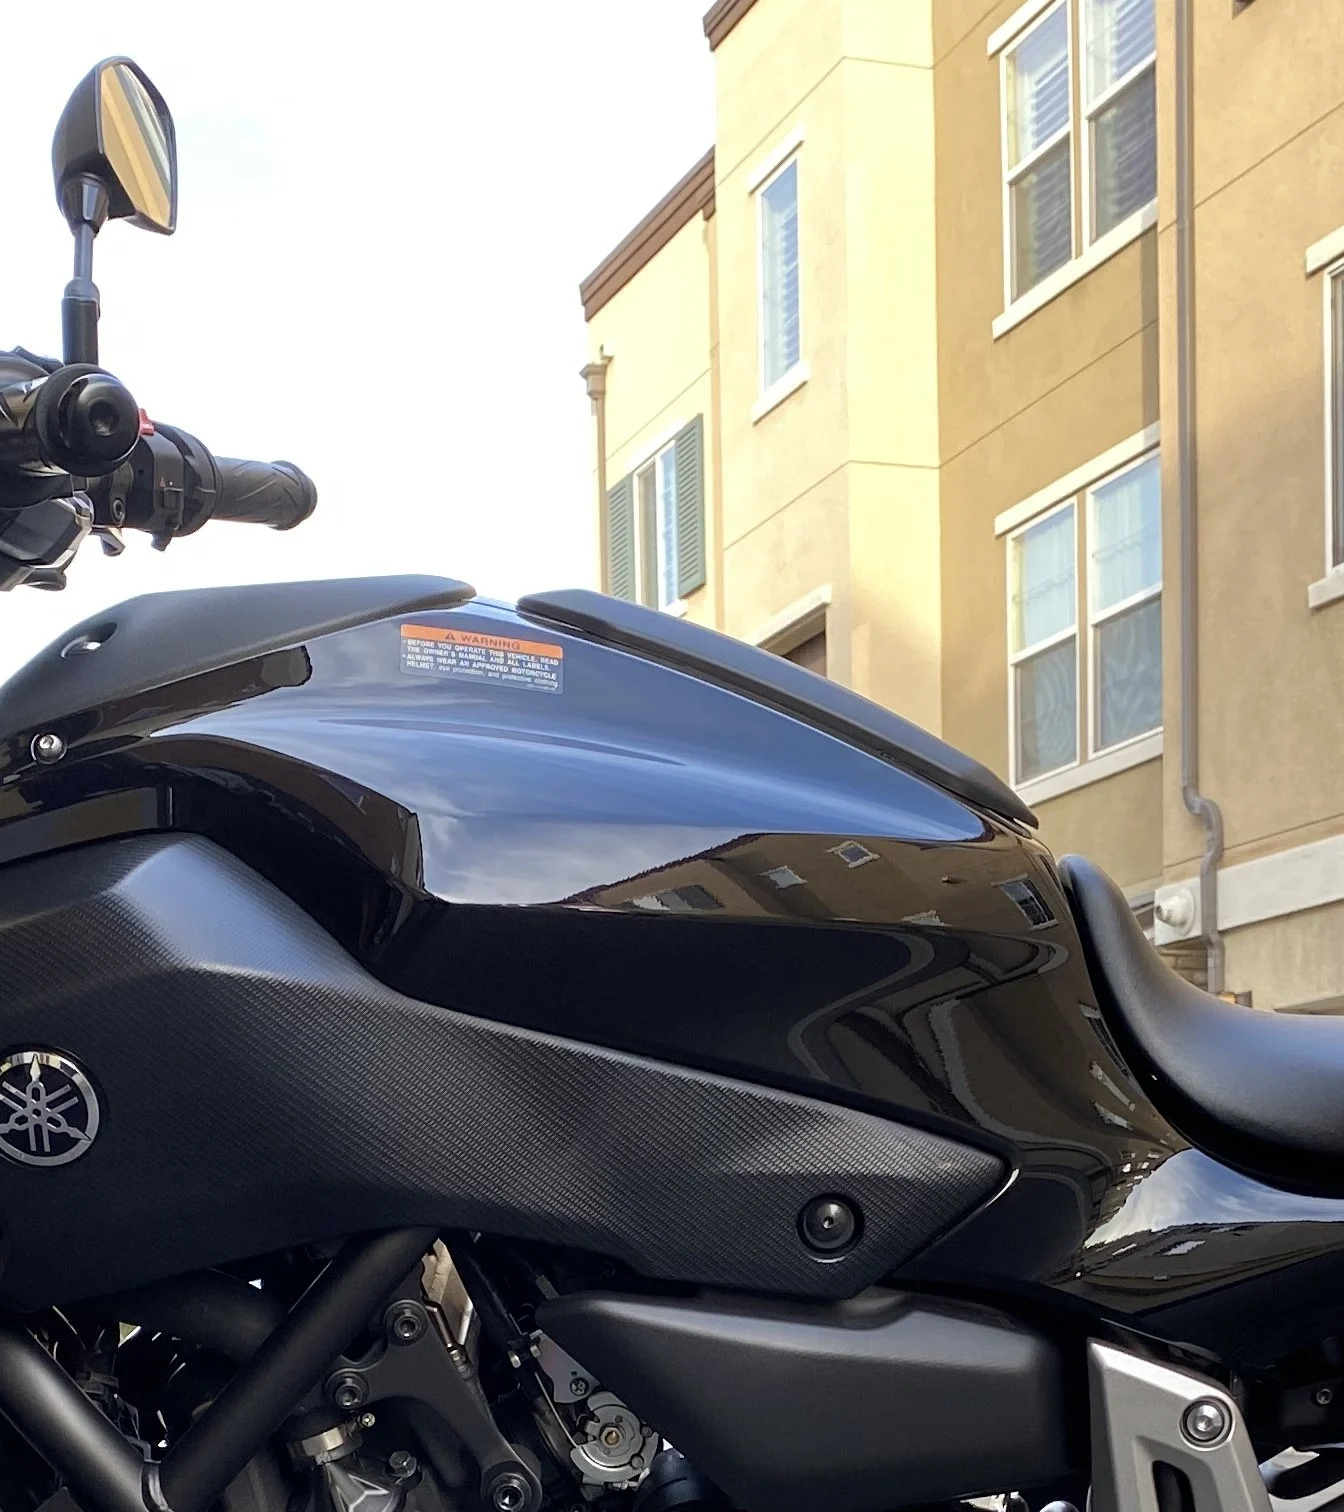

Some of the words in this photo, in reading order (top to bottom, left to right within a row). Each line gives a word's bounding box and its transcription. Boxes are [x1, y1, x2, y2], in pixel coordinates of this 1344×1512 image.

[407, 639, 434, 649] BEFORE
[438, 642, 452, 650] YOU
[455, 645, 485, 655] OPERATE
[461, 635, 520, 650] WARNING
[407, 654, 434, 662] ALWAYS
[437, 657, 456, 665] WEAR
[472, 662, 509, 672] APPROVED
[512, 668, 557, 680] MOTORCYCLE
